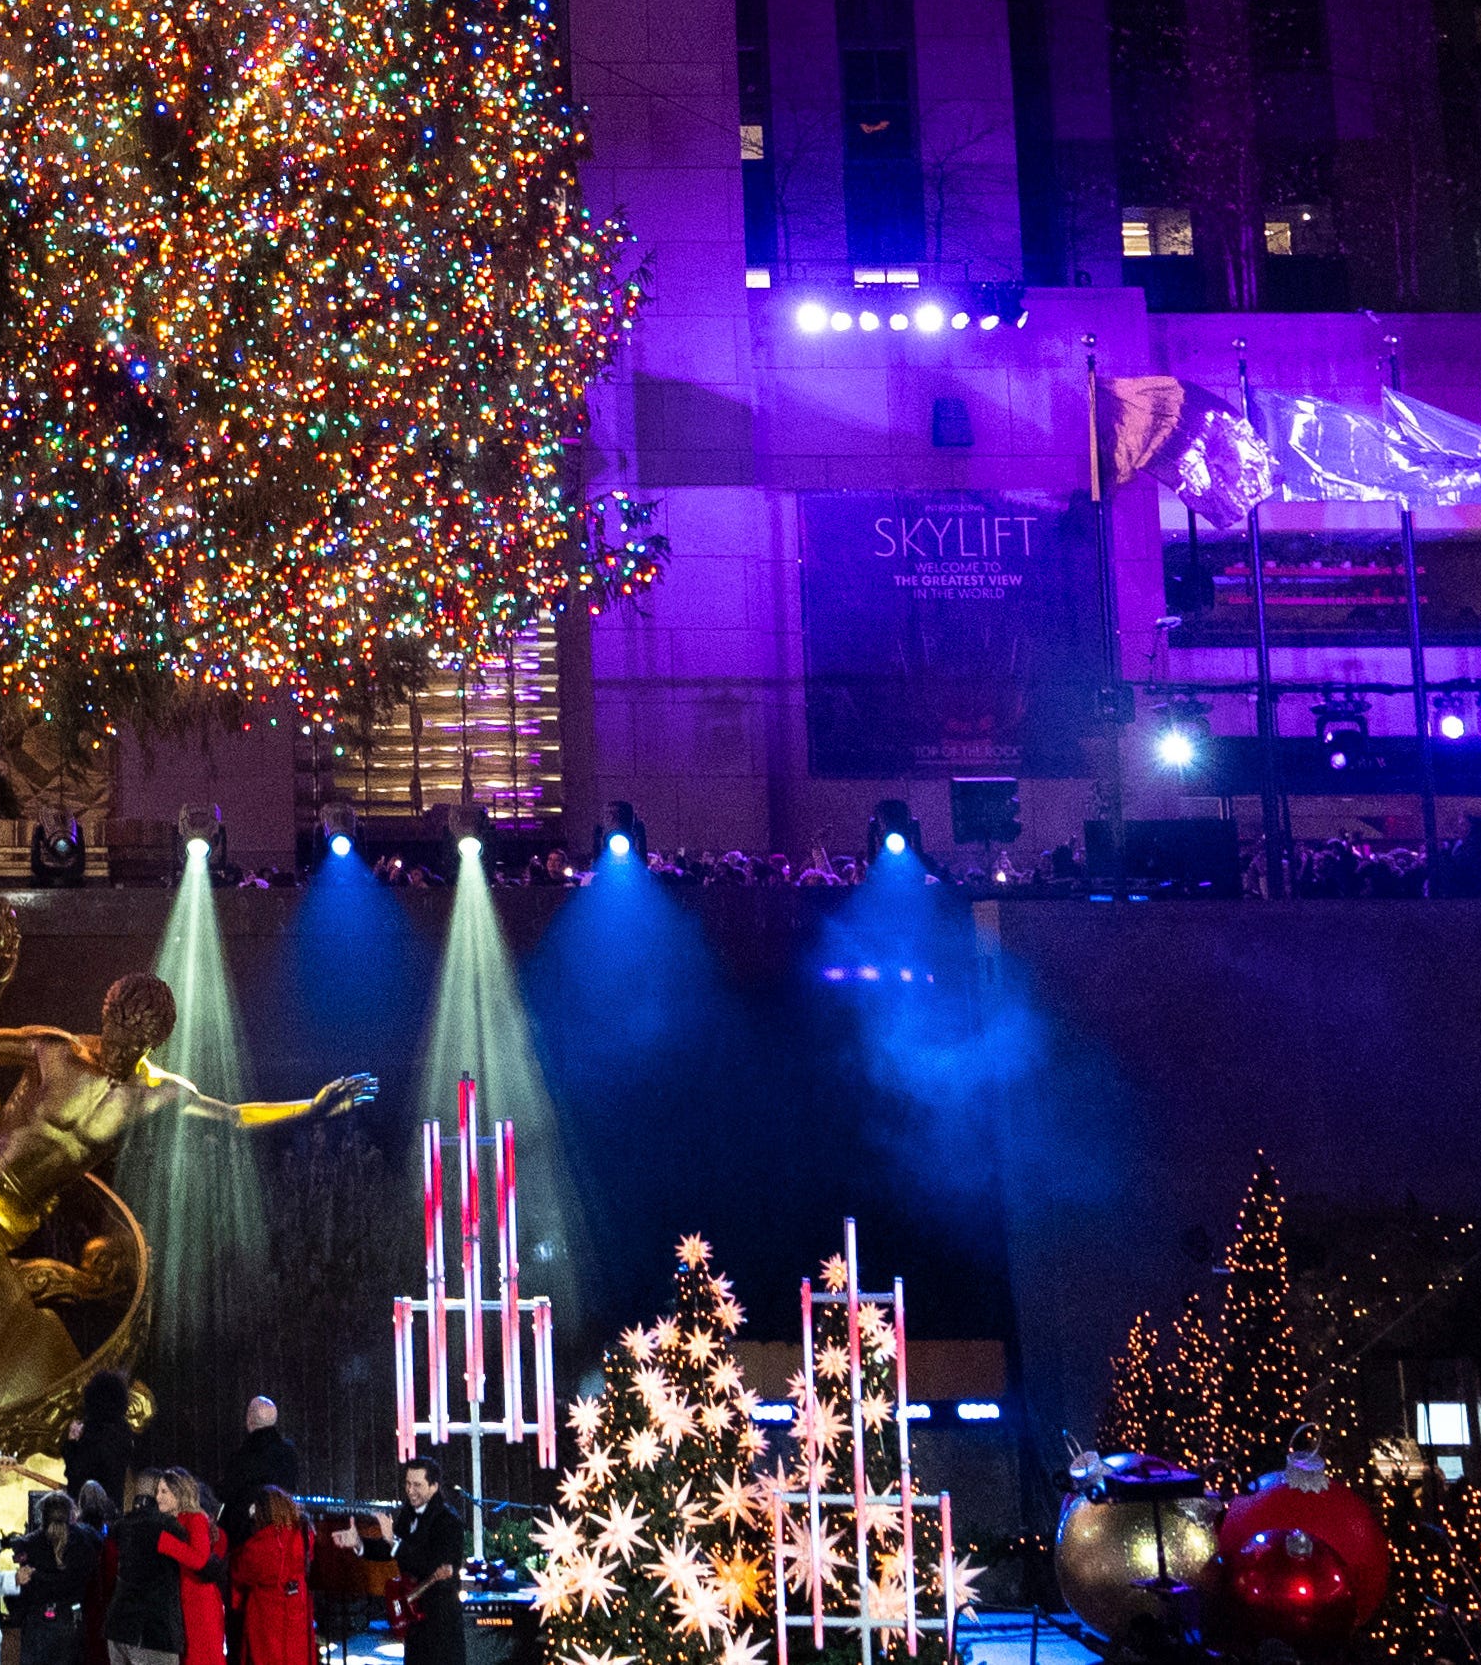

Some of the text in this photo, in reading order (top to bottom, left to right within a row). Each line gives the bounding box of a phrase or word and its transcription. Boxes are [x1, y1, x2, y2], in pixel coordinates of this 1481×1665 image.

[874, 516, 1038, 557] SKYLIFT
[915, 562, 1002, 574] WELCOME TO
[893, 575, 1023, 587] THE GREATEST VIEW
[913, 587, 1006, 599] IN THE WORLD
